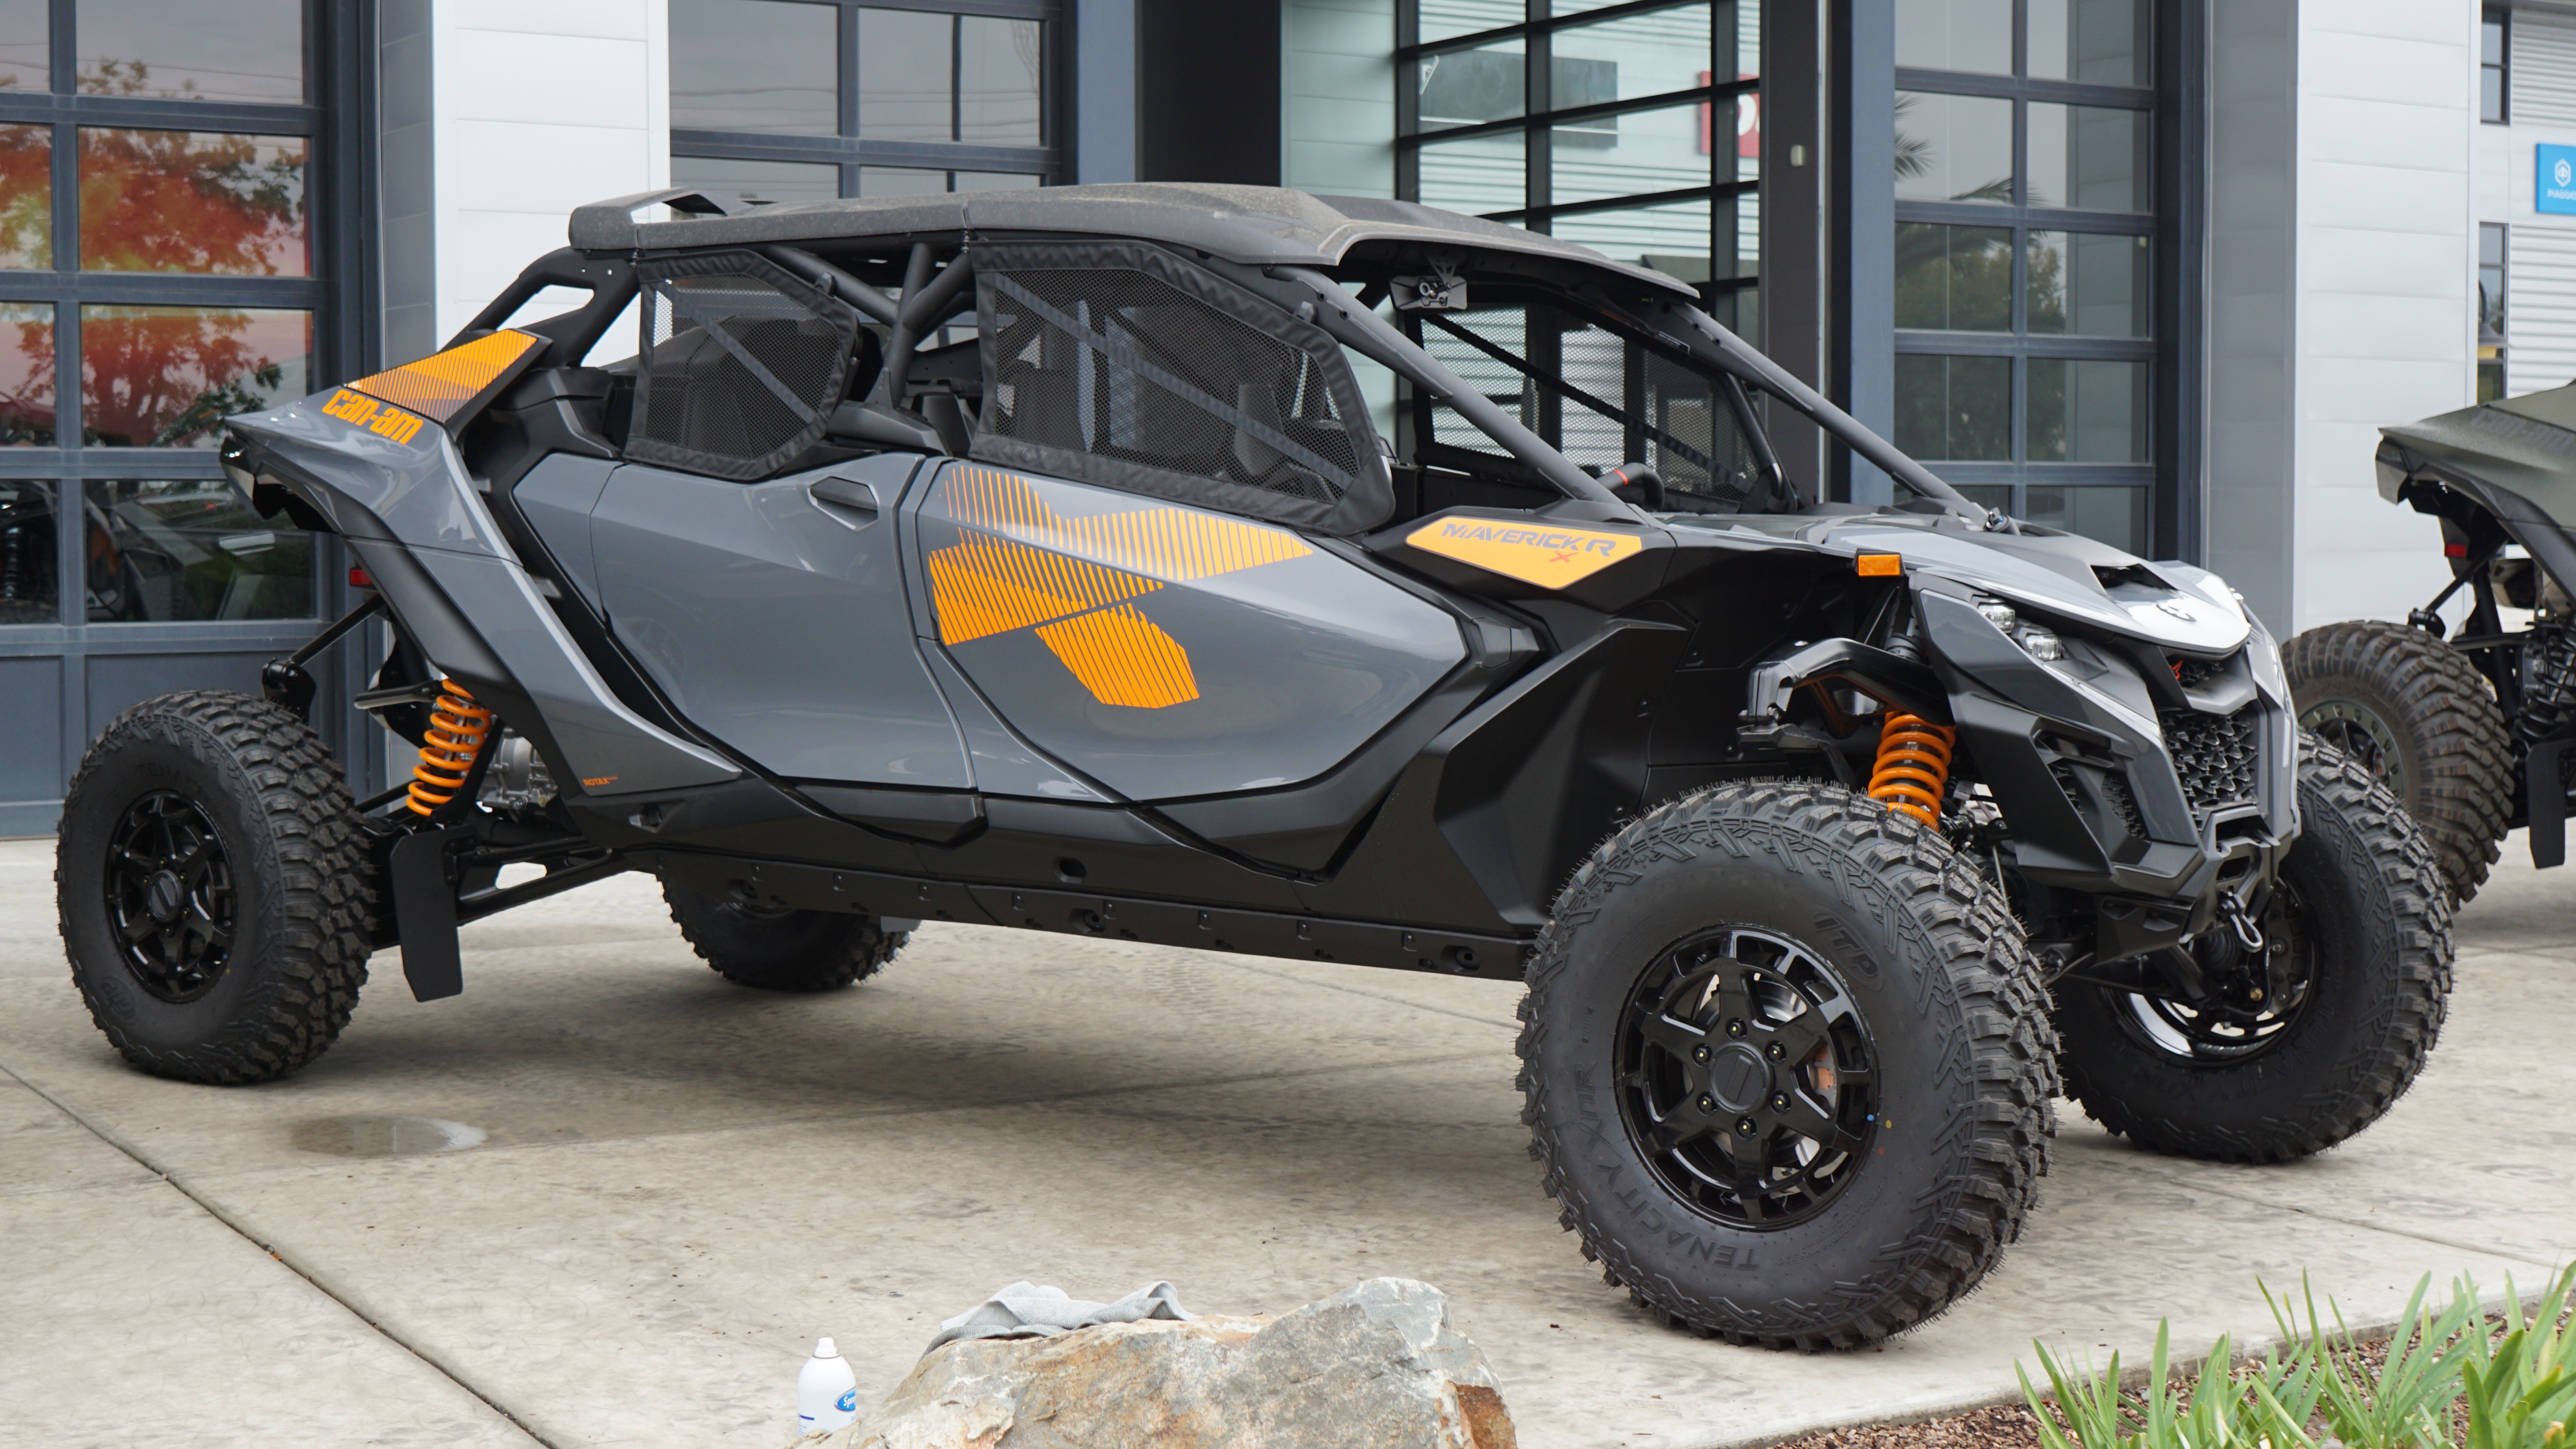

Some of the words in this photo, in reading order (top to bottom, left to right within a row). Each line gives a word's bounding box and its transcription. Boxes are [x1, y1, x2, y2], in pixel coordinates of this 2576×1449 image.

[1441, 523, 1586, 551] MAVERICK
[1585, 539, 1616, 558] R
[583, 777, 610, 786] ROTAX
[1814, 916, 1878, 978] ITP
[1596, 1164, 1761, 1272] TENACITY
